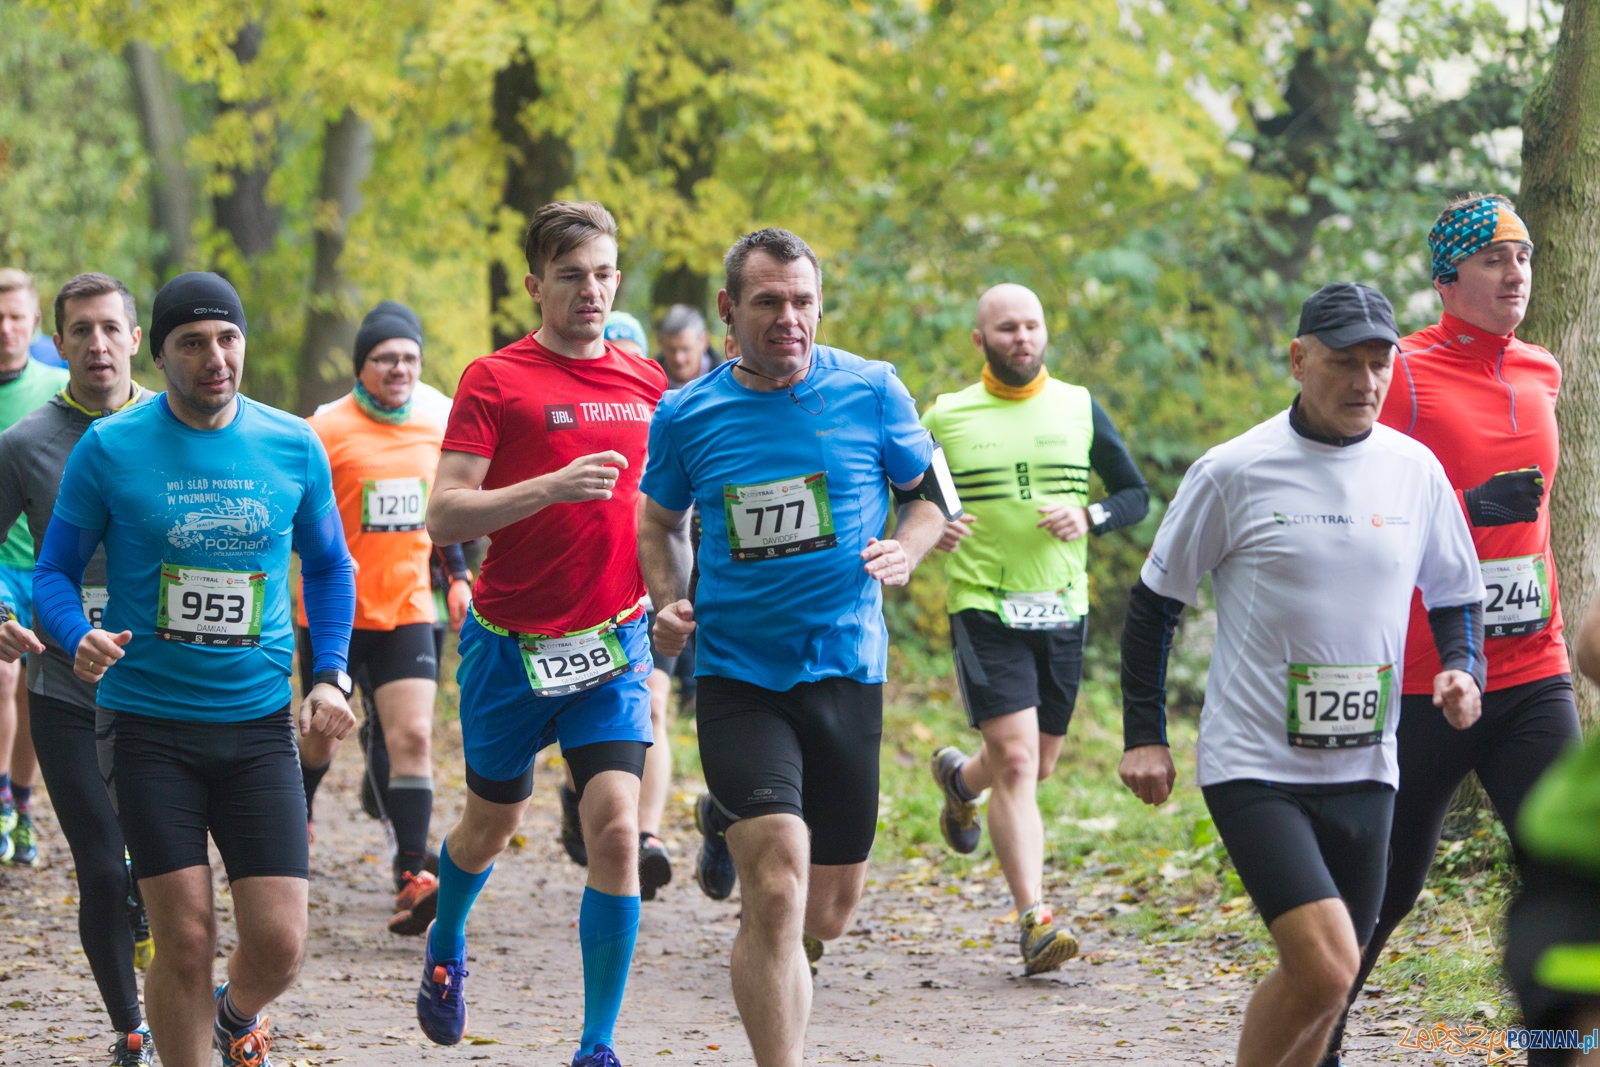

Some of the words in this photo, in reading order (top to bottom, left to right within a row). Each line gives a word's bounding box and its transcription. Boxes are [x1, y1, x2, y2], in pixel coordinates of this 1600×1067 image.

[551, 411, 573, 424] JBL
[167, 494, 176, 505] W
[377, 495, 418, 515] 1210
[746, 500, 804, 536] 777
[763, 533, 799, 545] DAVIDOFF
[182, 591, 244, 623] 953
[1010, 604, 1064, 618] 1224
[197, 624, 227, 633] DAMIAN
[537, 647, 611, 679] 1298
[561, 670, 599, 684] SEBASTIAN
[1305, 690, 1378, 721] 1268
